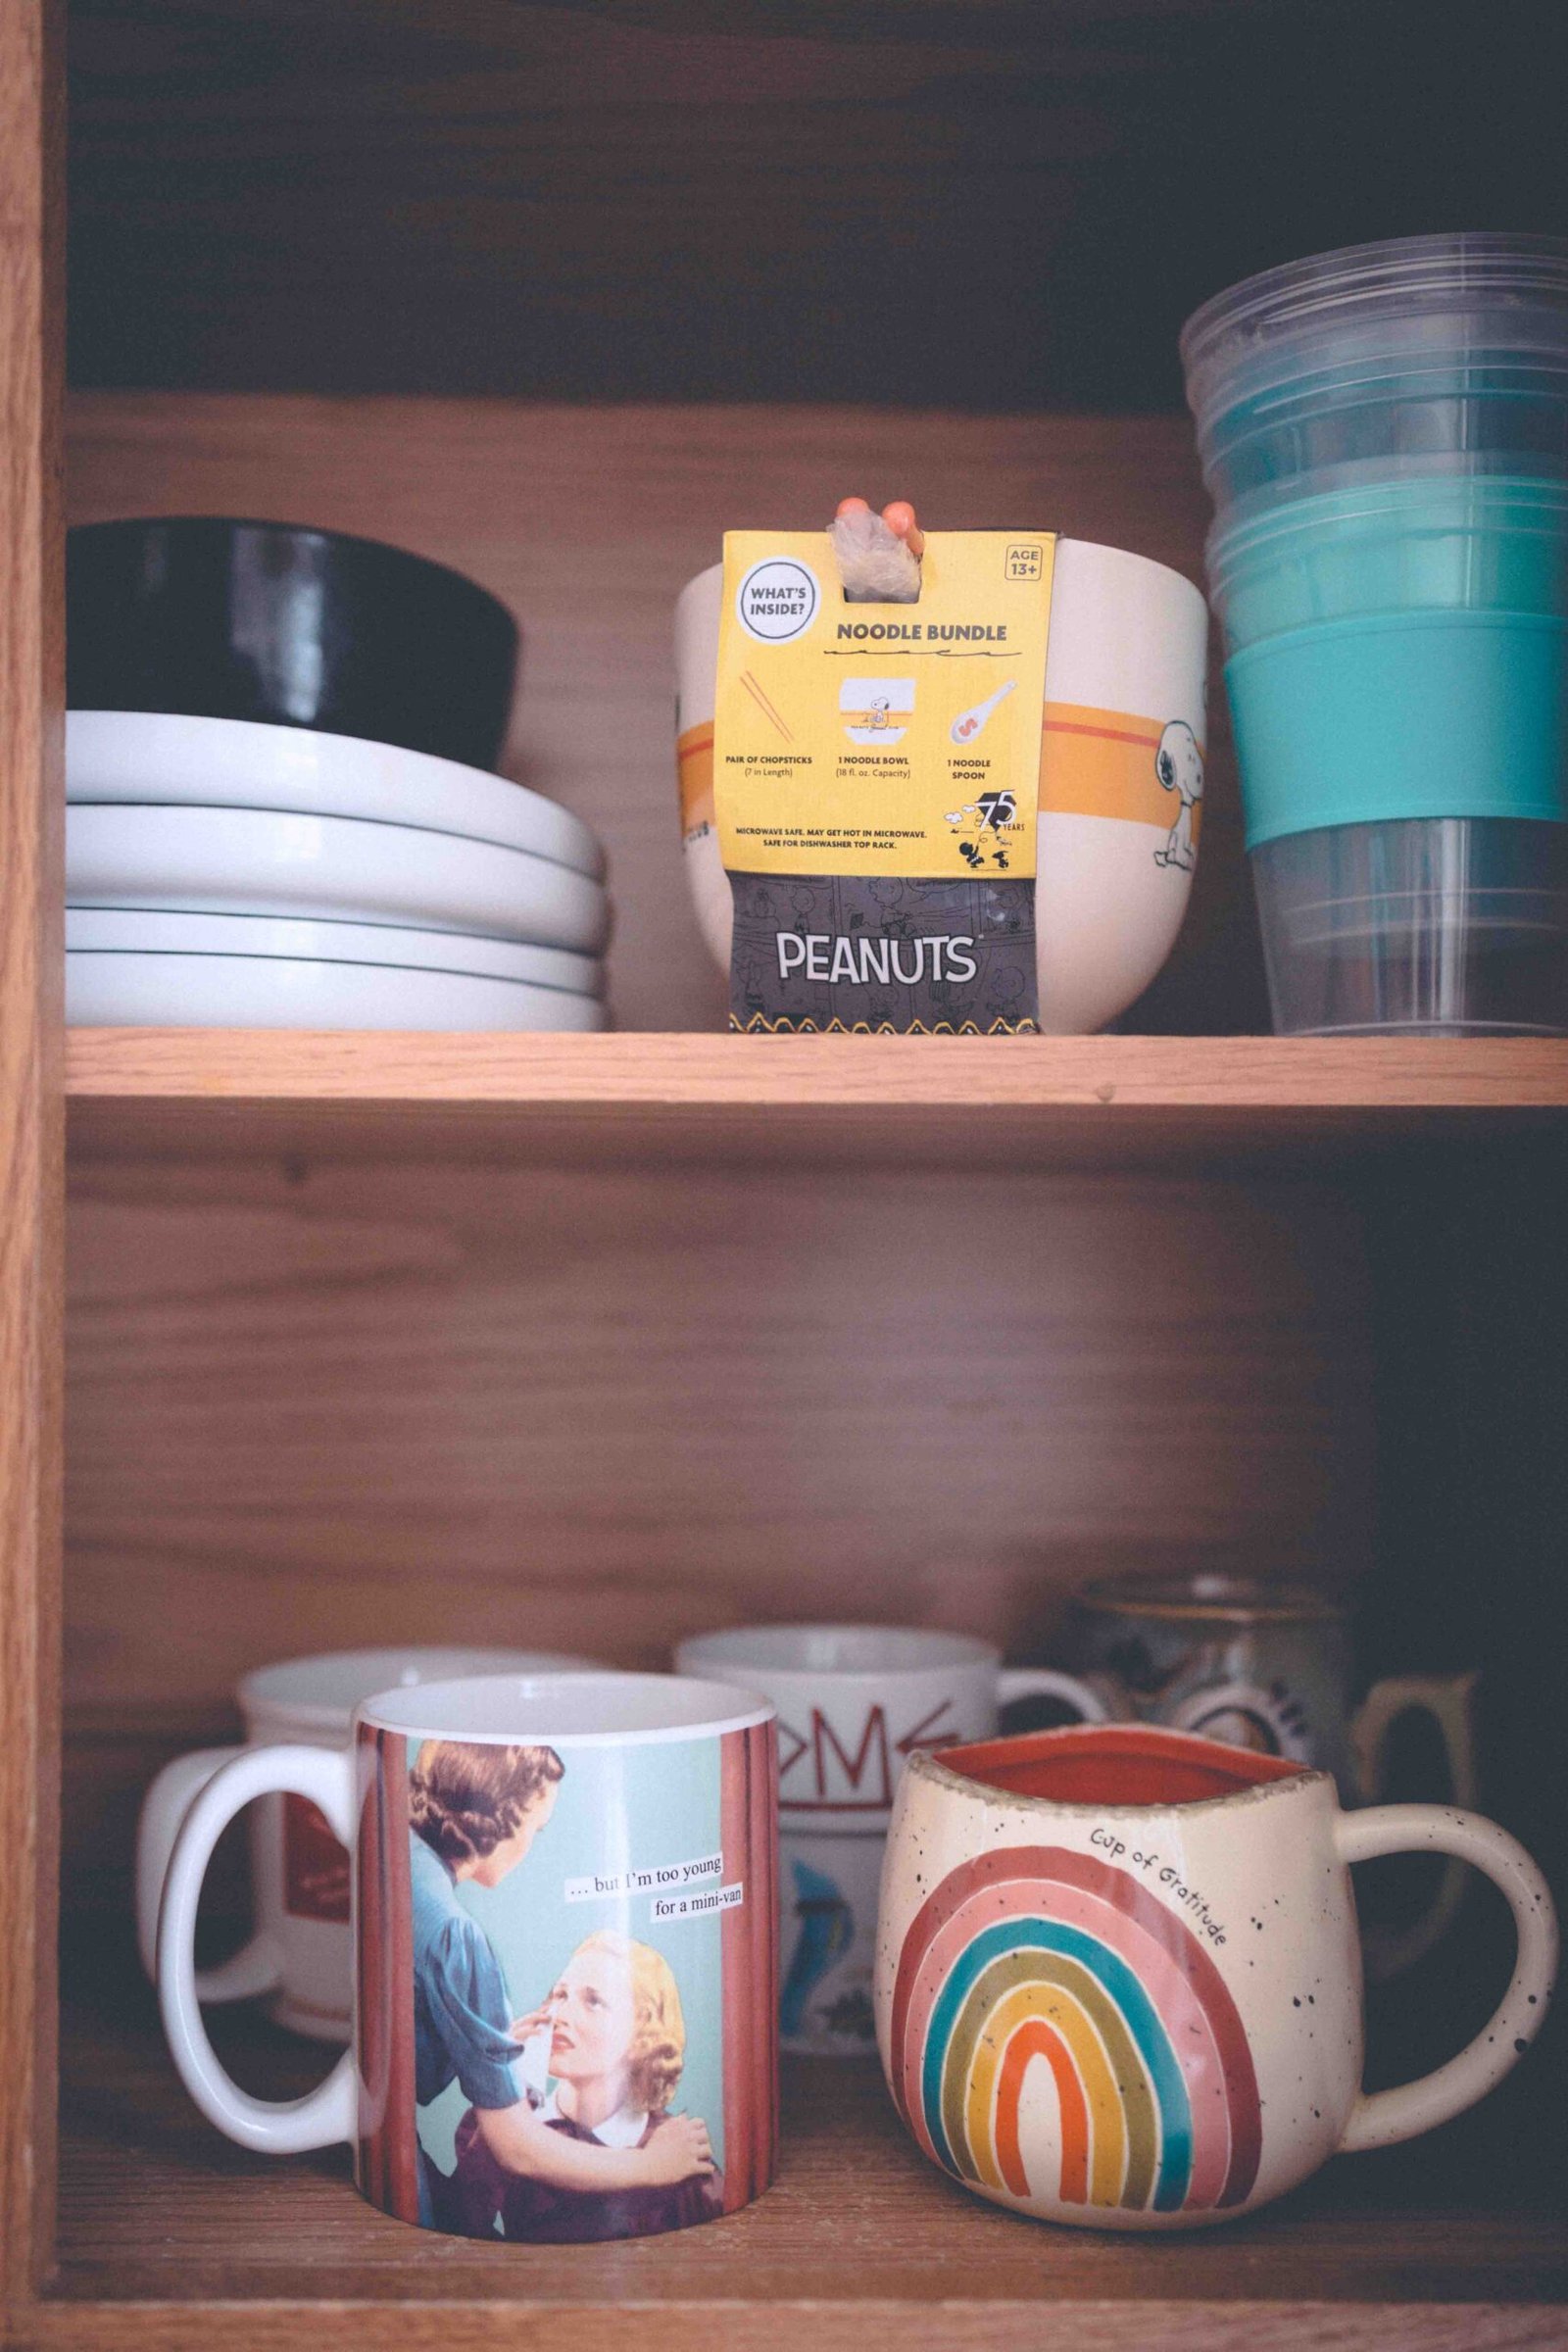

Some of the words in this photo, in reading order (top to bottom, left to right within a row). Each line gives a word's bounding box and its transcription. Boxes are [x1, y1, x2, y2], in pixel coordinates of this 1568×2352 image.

[1009, 550, 1039, 561] AGE
[1010, 563, 1037, 576] 13+
[751, 587, 807, 600] WHAT'S
[750, 603, 806, 616] INSIDE?
[837, 623, 921, 641] NOODLE
[927, 624, 1007, 642] BUNDLE
[760, 756, 812, 764] CHOPSTICKS
[745, 767, 752, 777] (7
[754, 767, 761, 776] in
[763, 767, 793, 778] Length)
[836, 767, 848, 778] (18
[849, 767, 858, 777] fl.
[872, 769, 911, 779] Capacity)
[975, 789, 1017, 832] 75
[735, 827, 783, 836] MICROWAVE
[874, 830, 928, 839] MICROWAVE.
[1003, 823, 1026, 832] YEARS
[872, 841, 898, 850] RACK.
[775, 931, 978, 985] PEANUTS
[594, 1877, 619, 1893] but
[625, 1872, 652, 1889] I'm
[657, 1869, 679, 1884] too
[683, 1857, 721, 1882] young
[1090, 1828, 1126, 1858] Cup
[1132, 1850, 1159, 1870] of
[1159, 1867, 1227, 1946] Gratitude
[656, 1899, 676, 1916] for
[679, 1900, 687, 1912] a
[691, 1887, 742, 1911] mini-van
